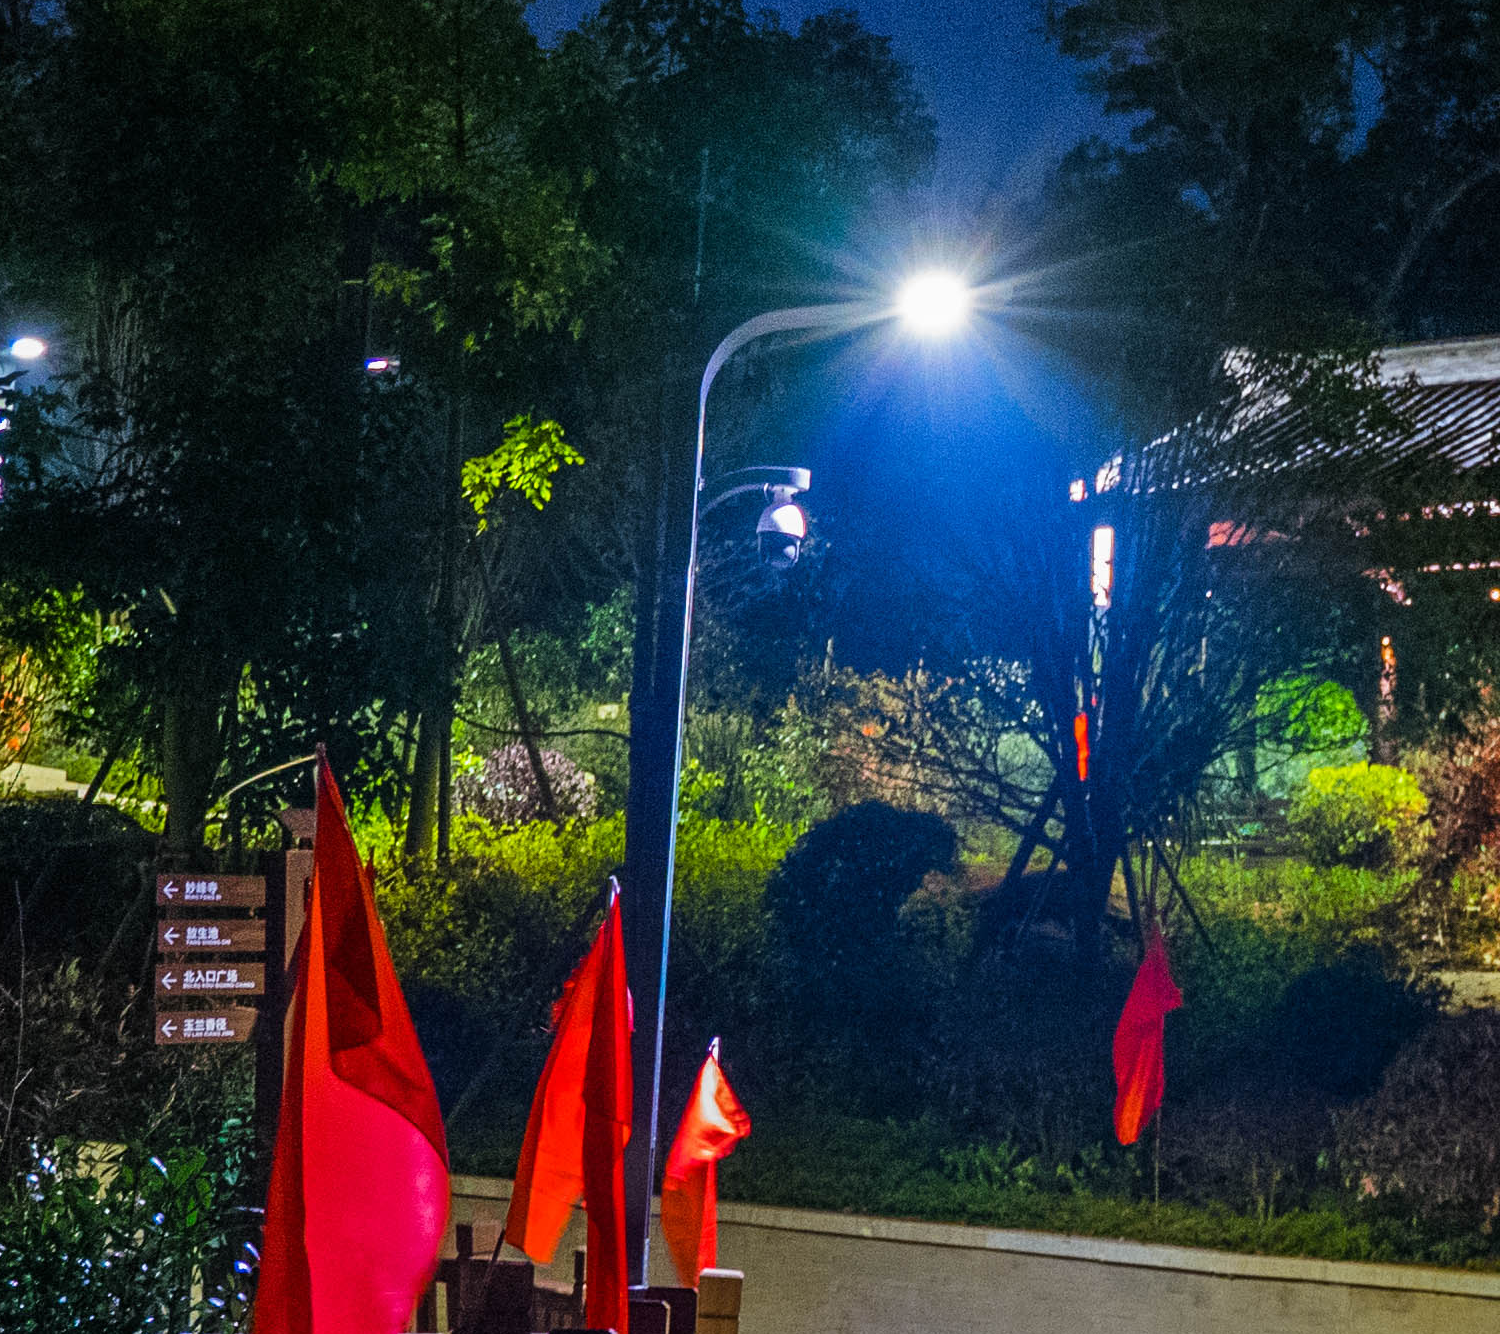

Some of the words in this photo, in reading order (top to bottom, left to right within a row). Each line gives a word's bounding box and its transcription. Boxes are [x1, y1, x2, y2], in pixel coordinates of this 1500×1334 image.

[183, 969, 238, 983] 北入口广场
